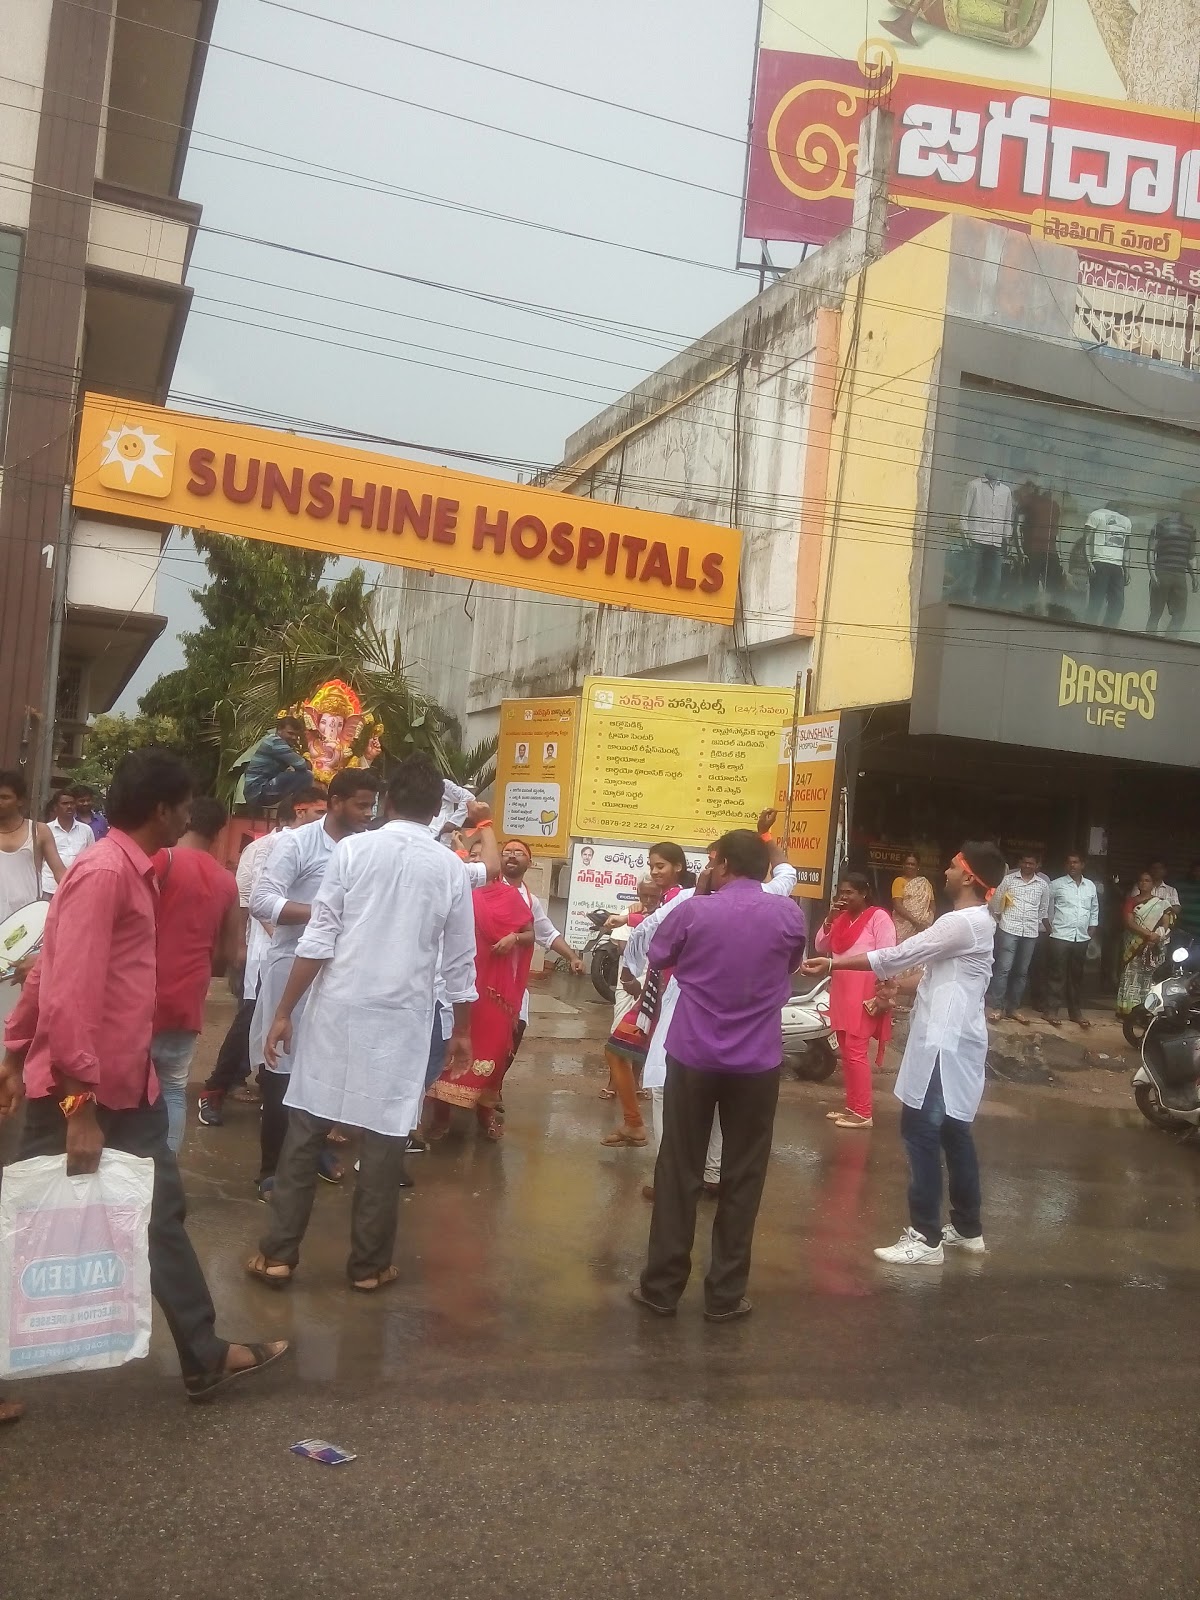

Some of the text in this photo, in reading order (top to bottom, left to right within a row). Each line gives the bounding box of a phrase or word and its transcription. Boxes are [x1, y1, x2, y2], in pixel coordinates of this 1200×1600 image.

[898, 95, 1200, 220] జగదా
[1043, 217, 1171, 253] షాపింగ్ మాల్
[186, 447, 725, 594] SUNSHINE HOSPITALS
[41, 544, 55, 569] 1
[1058, 653, 1158, 720] BASICS
[668, 698, 726, 715] హాస్పిటల్స్
[759, 704, 789, 715] సేవలు)
[1086, 706, 1127, 729] LIFE
[799, 726, 834, 741] SUNSHINE
[795, 773, 813, 786] 24/7
[600, 819, 631, 827] 0878-22
[790, 820, 808, 834] 24/7
[576, 868, 638, 891] సన్‌షైన్ హాస్పి
